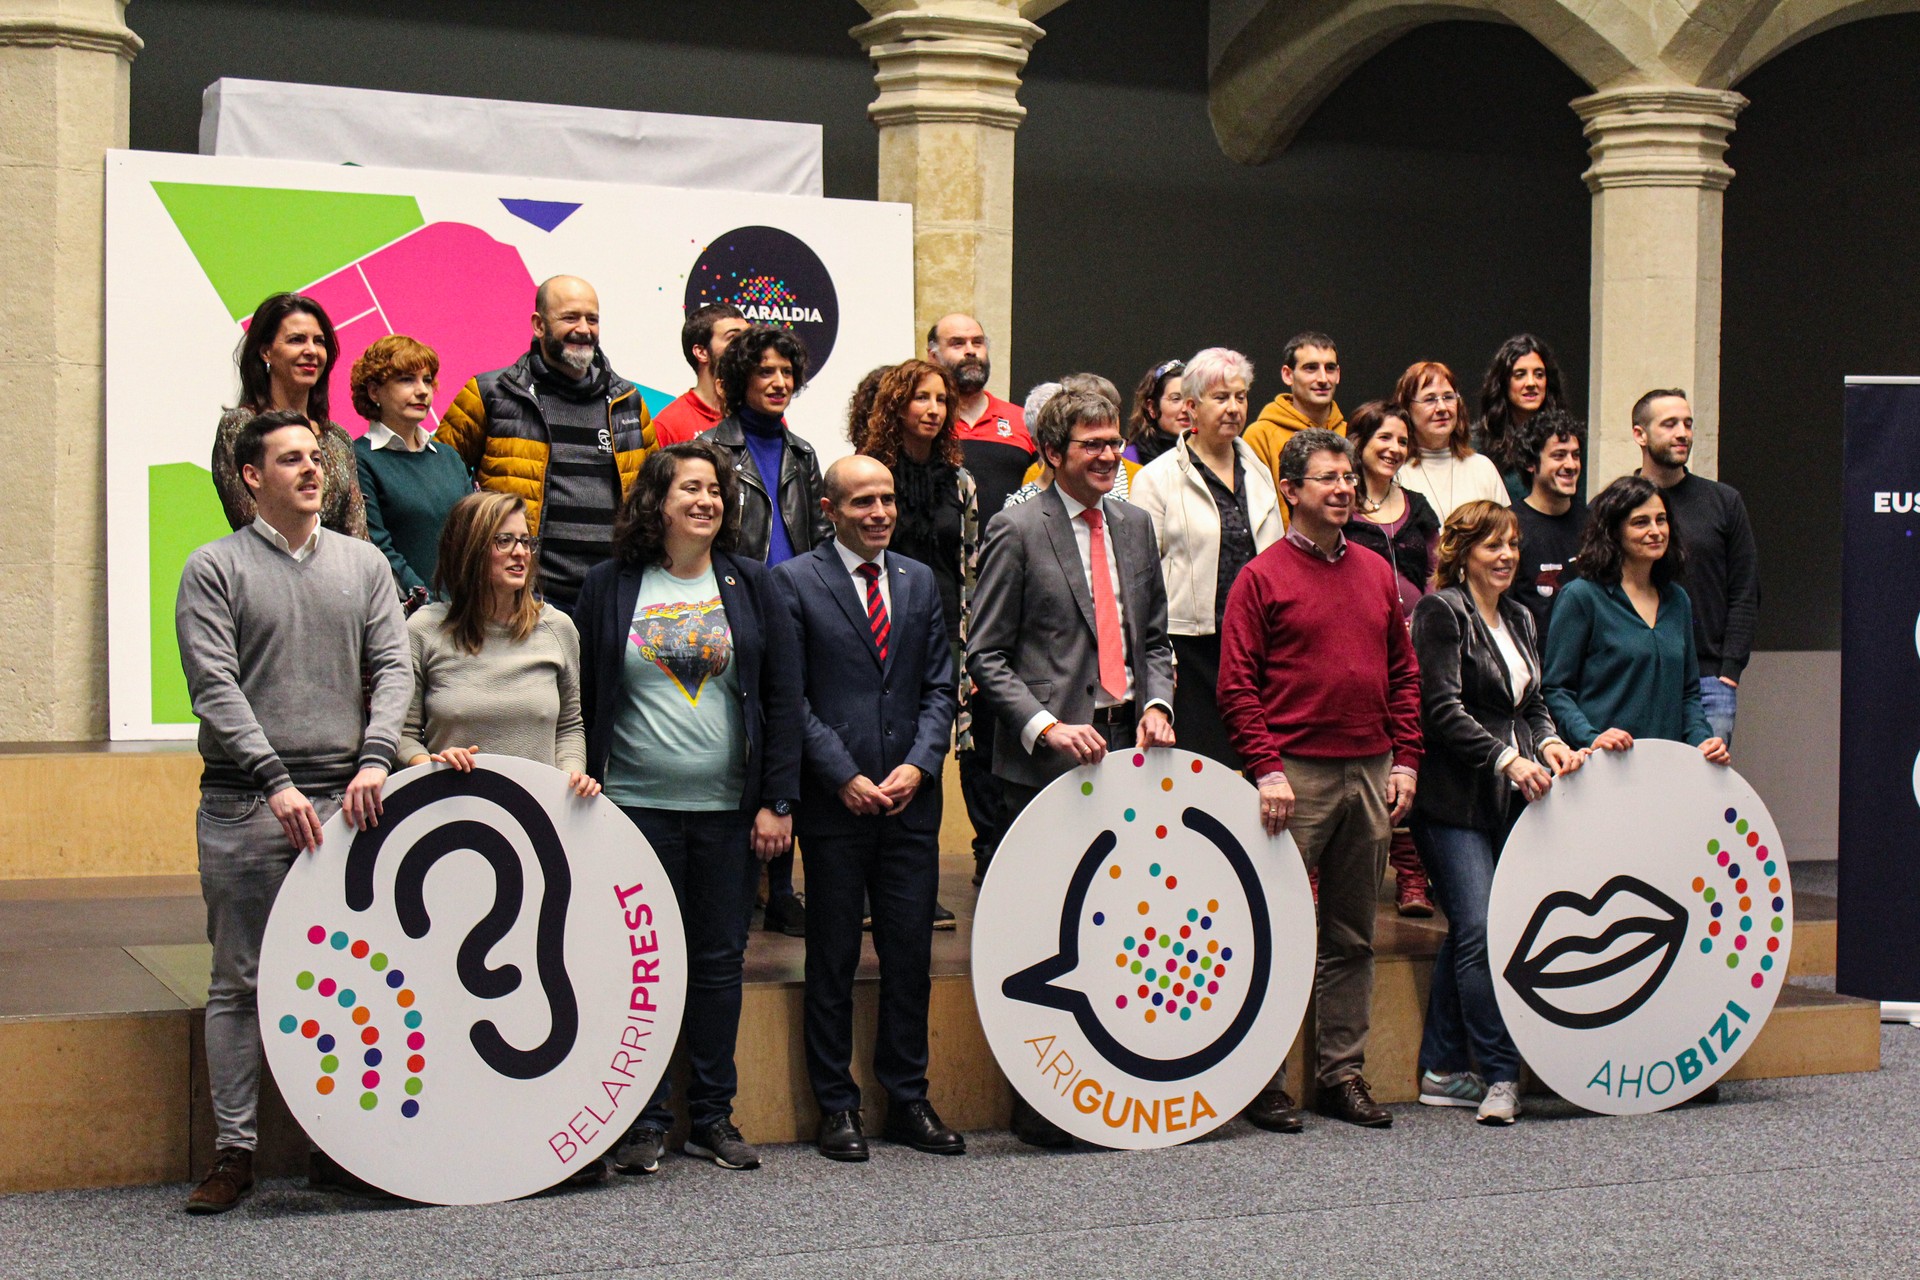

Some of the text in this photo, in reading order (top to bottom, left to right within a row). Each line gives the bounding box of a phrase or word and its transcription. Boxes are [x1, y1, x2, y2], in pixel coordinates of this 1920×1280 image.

[700, 302, 824, 323] KARALDIA
[548, 882, 660, 1164] BELARRIPREST
[1586, 1000, 1751, 1098] AHOBIZI
[1024, 1035, 1218, 1134] ARIGUNEA
